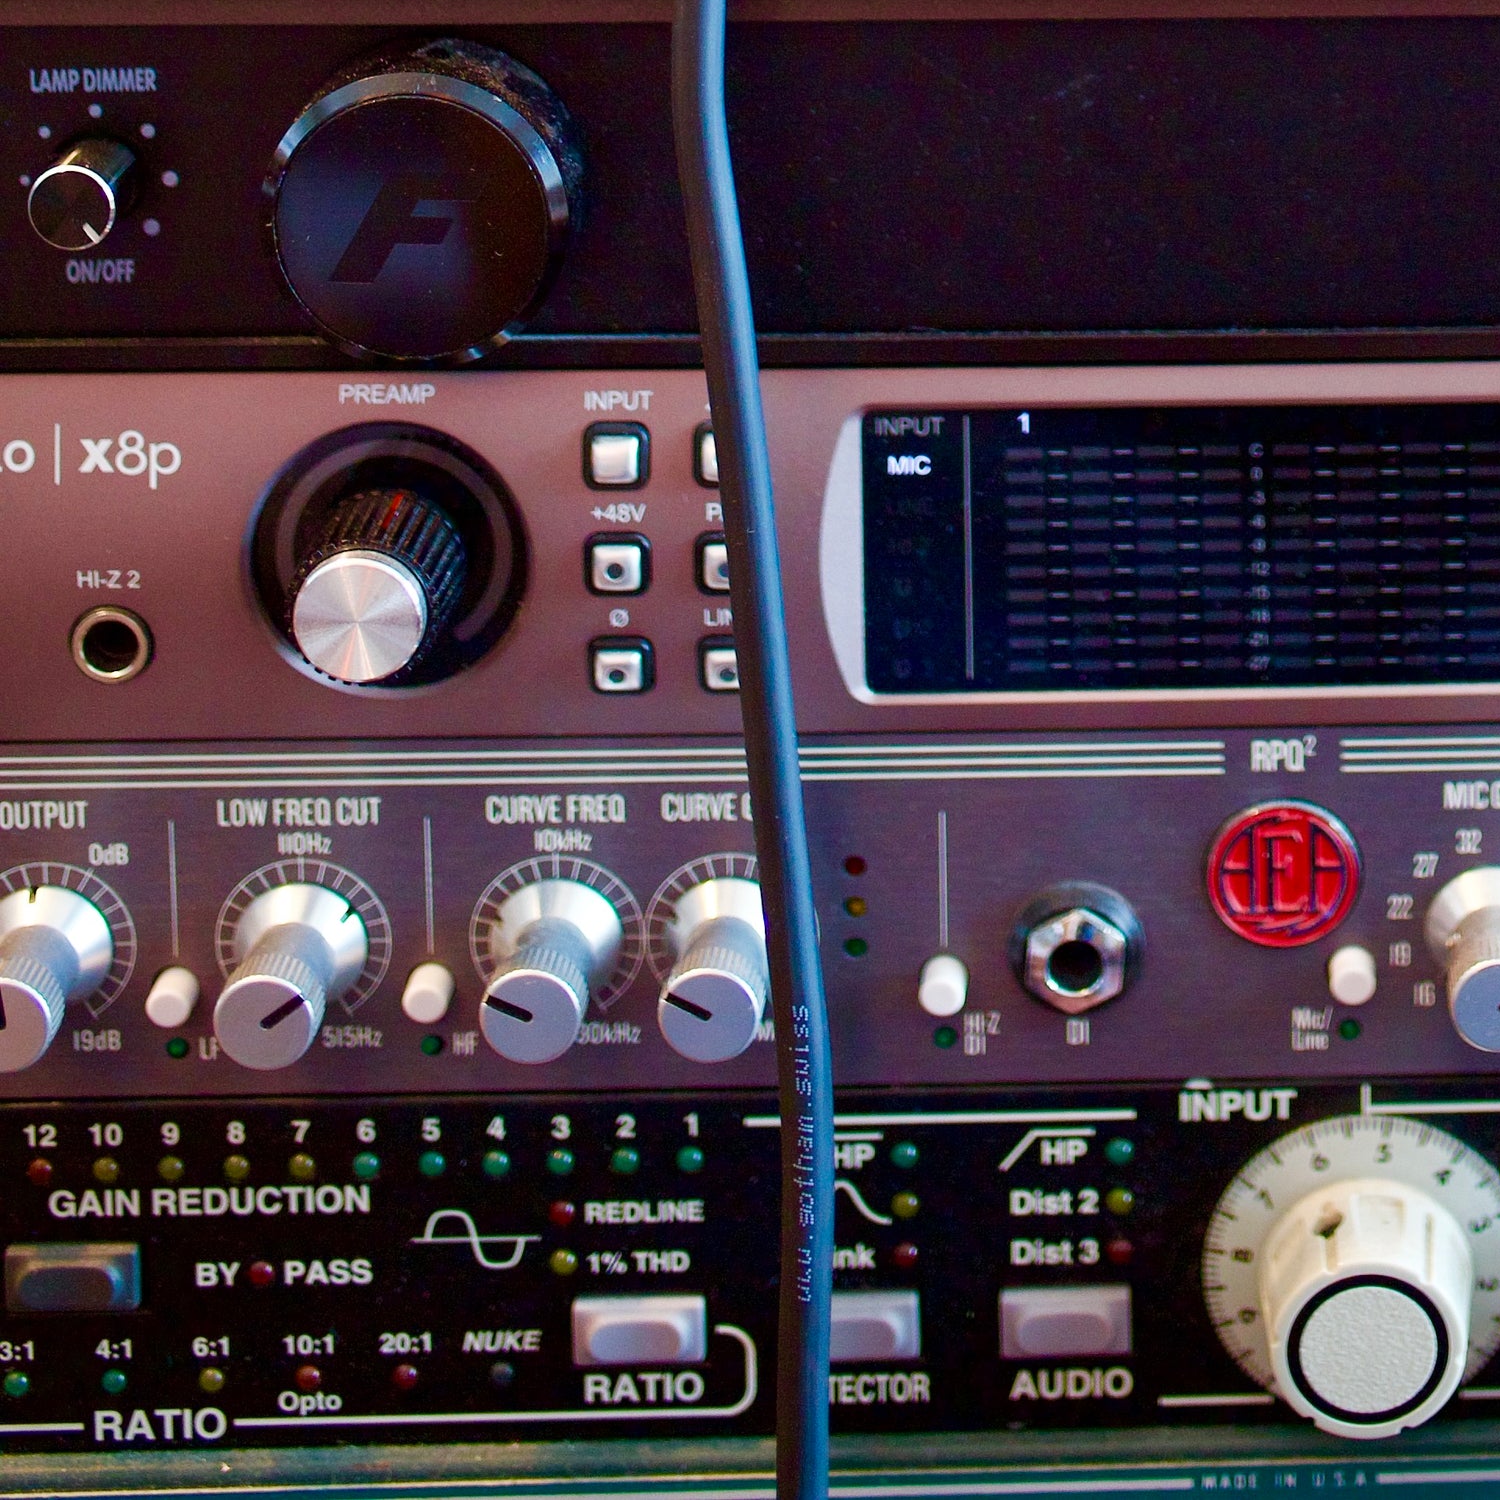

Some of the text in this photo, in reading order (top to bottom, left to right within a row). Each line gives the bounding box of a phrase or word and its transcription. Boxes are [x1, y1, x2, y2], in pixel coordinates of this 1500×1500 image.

[30, 68, 157, 93] LAMP DIMMER
[65, 259, 136, 285] ON/OFF
[338, 384, 435, 405] PREAMP
[583, 390, 653, 412] INPUT
[874, 416, 945, 437] INPUT
[1016, 412, 1031, 434] 1
[77, 428, 182, 490] x8p
[886, 454, 932, 476] MIC
[589, 503, 648, 523] +48V
[76, 570, 141, 589] HI-Z 2
[703, 609, 734, 627] LIN
[485, 794, 627, 824] CURVE FREQ
[661, 793, 738, 822] CURVE
[1443, 782, 1489, 810] MIC
[0, 800, 88, 830] OUTPUT
[216, 797, 382, 827] LOW FREQ CUT
[1179, 1089, 1298, 1122] INPUT
[22, 1112, 700, 1147] 12 10 9 8 7 6 5 4 3 2 1
[833, 1143, 876, 1170] HP
[1040, 1138, 1088, 1166] HP
[48, 1185, 371, 1218] GAIN REDUCTION
[583, 1199, 705, 1224] REDLINE
[1009, 1187, 1099, 1216] Dist 2
[586, 1250, 691, 1275] 1% THD
[832, 1244, 876, 1271] ink
[1009, 1238, 1099, 1266] Dist 3
[194, 1258, 373, 1288] BY PASS
[0, 1329, 542, 1363] 3:1 4:1 6:1 10:1 20:1 NUKE
[583, 1370, 705, 1404] RATIO
[828, 1373, 931, 1405] TECTOR
[1009, 1367, 1134, 1400] AUDIO
[277, 1391, 343, 1416] Opto
[93, 1407, 228, 1442] RATIO
